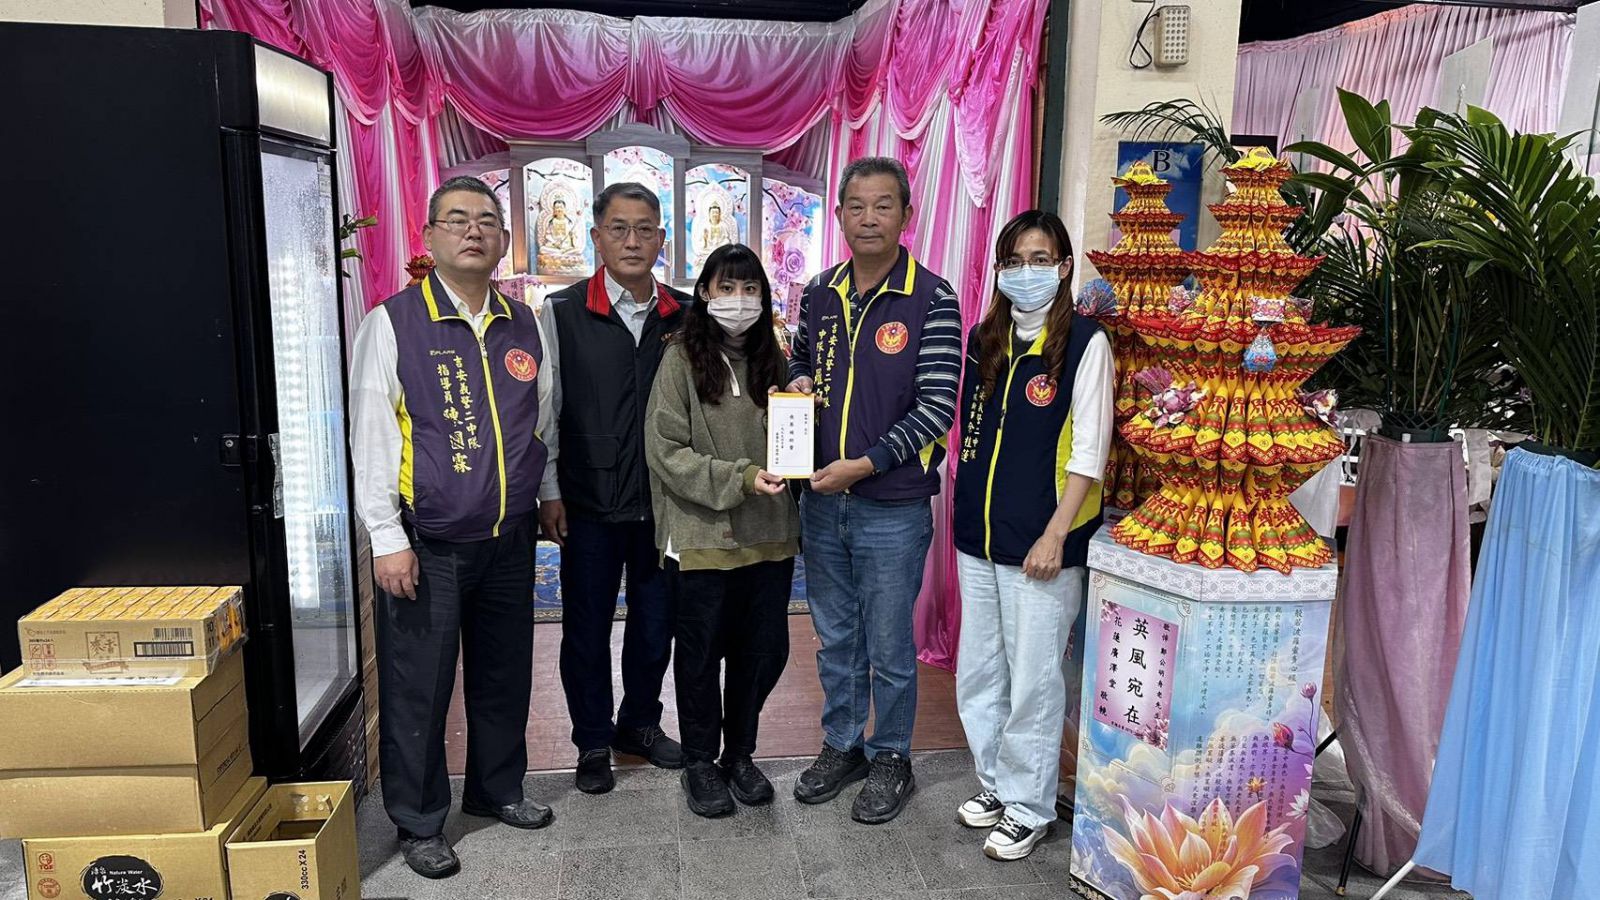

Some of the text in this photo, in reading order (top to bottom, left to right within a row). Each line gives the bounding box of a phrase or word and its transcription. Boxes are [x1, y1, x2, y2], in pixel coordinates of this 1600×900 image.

[1153, 150, 1171, 172] B
[453, 355, 481, 449] 吉安義警二中隊
[1123, 618, 1149, 725] 英風宛在
[298, 849, 306, 860] 24
[91, 875, 158, 895] 竹炭水
[300, 866, 309, 889] 330cc
